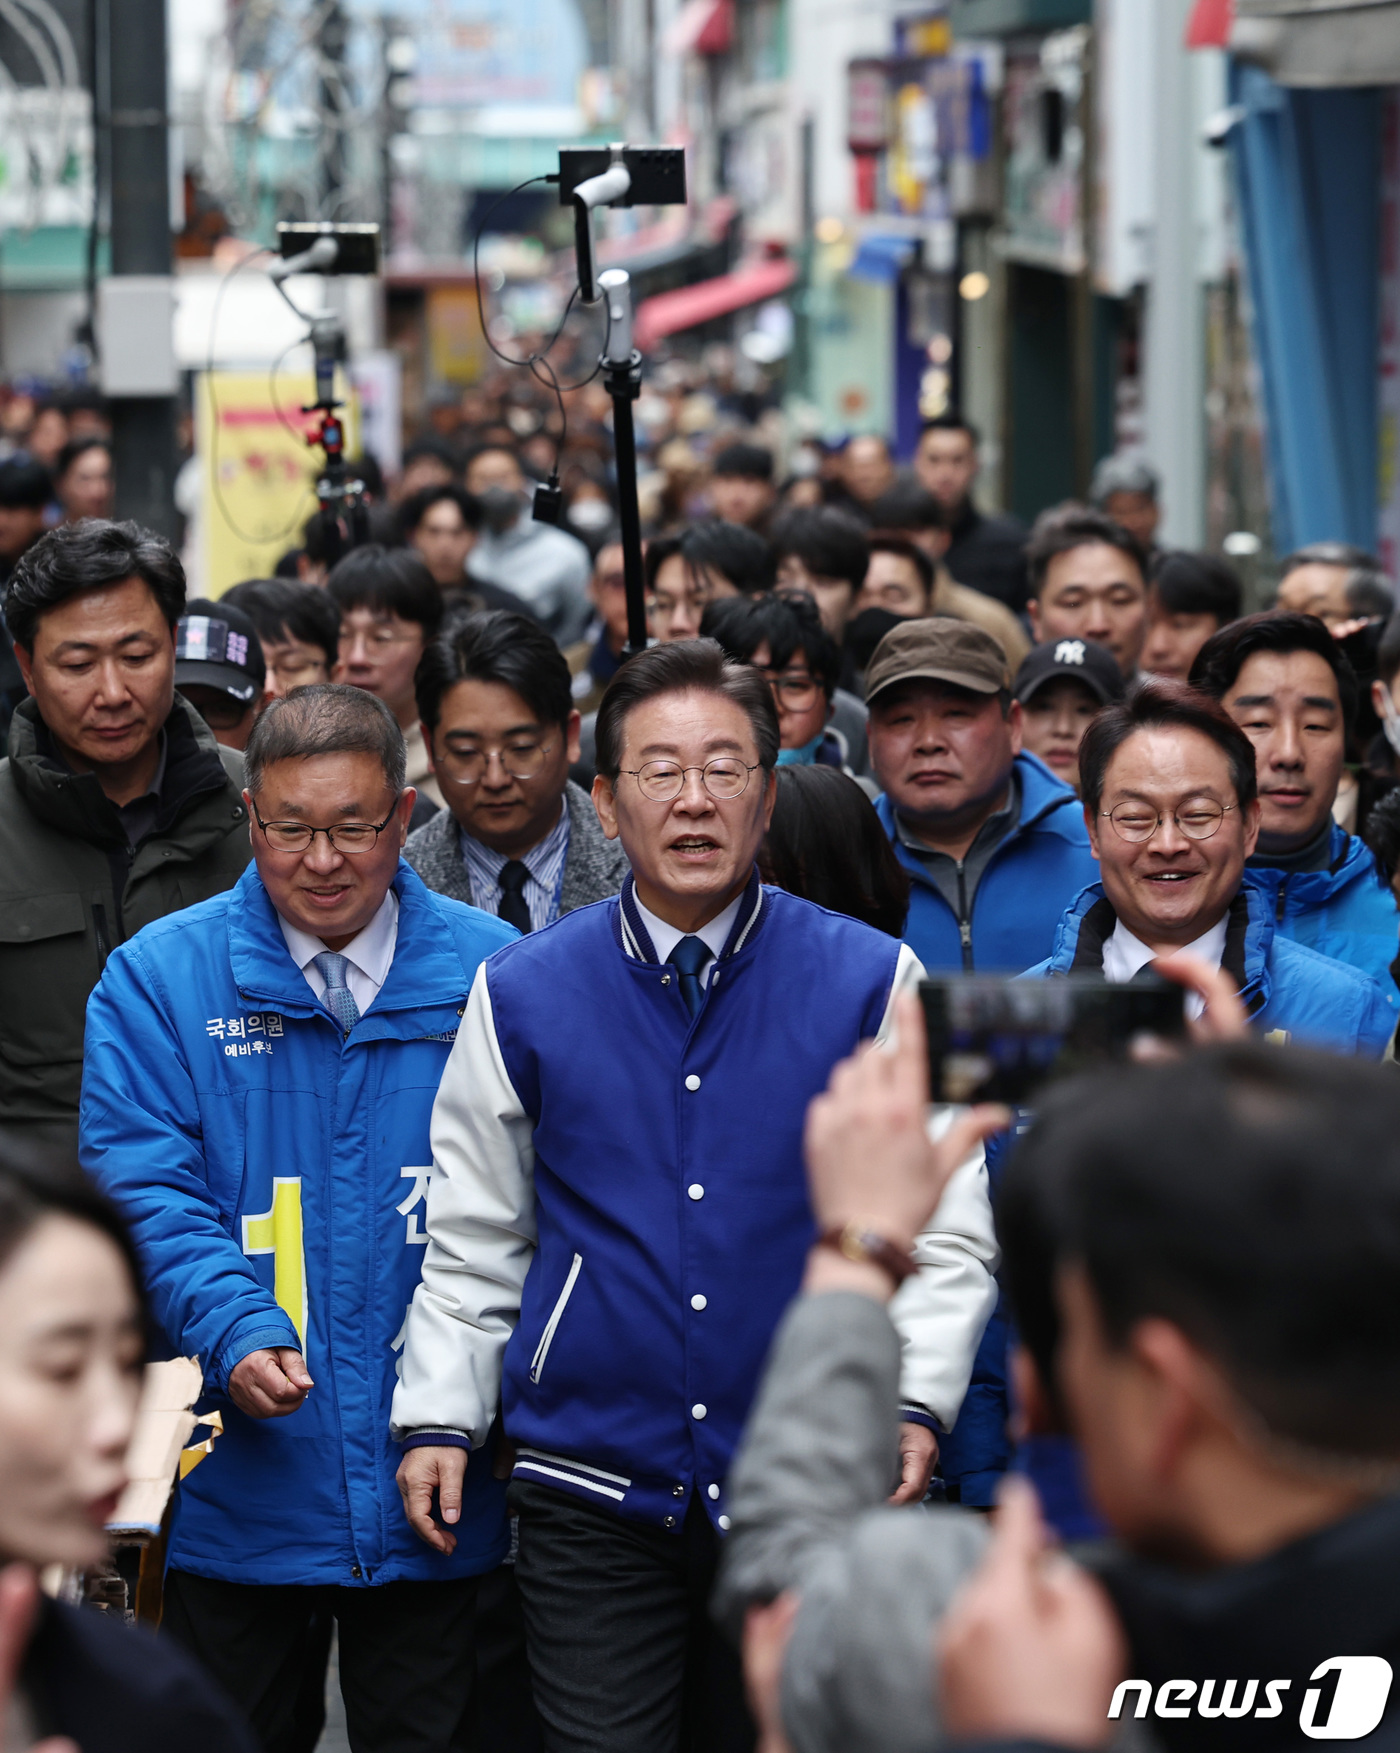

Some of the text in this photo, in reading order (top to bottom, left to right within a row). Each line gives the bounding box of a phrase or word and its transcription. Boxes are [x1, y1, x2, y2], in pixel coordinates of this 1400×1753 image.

[205, 1013, 284, 1040] 국회의원
[224, 1040, 274, 1057] 예비후보
[241, 1176, 308, 1398] 1
